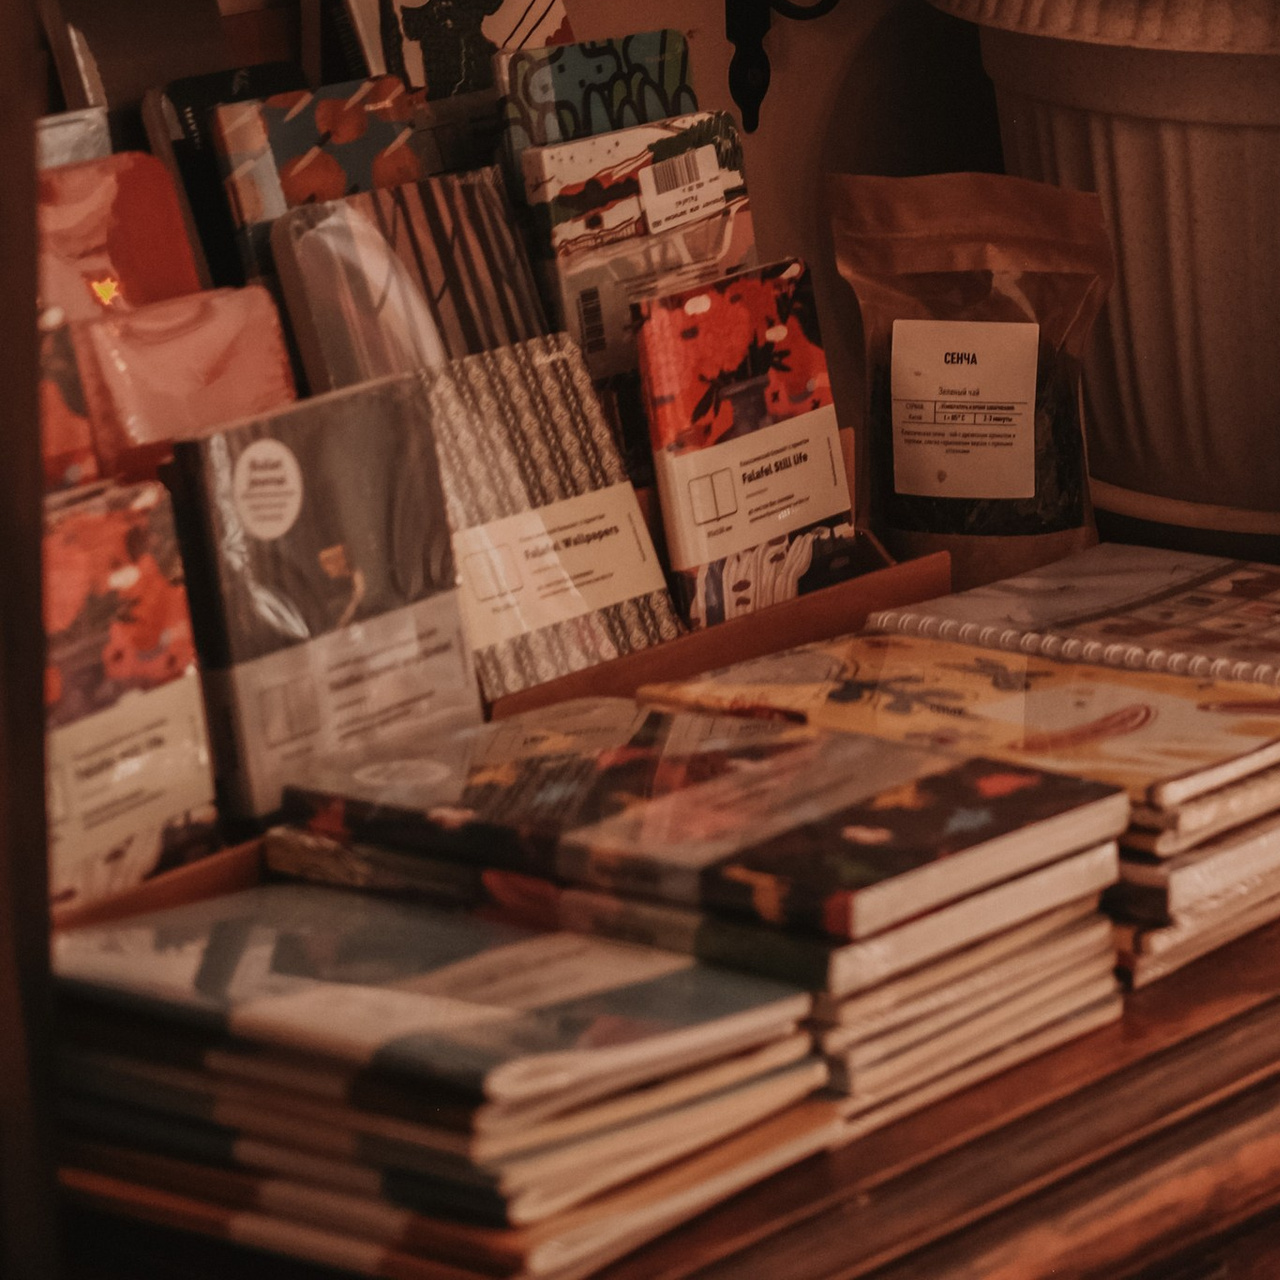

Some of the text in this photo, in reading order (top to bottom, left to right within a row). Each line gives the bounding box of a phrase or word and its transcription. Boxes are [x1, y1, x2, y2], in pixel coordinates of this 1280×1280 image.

[944, 352, 978, 365] СЕНЧА
[742, 464, 773, 485] Falafel
[774, 455, 793, 473] Still
[794, 452, 808, 466] Life
[562, 526, 620, 549] Wallpapers
